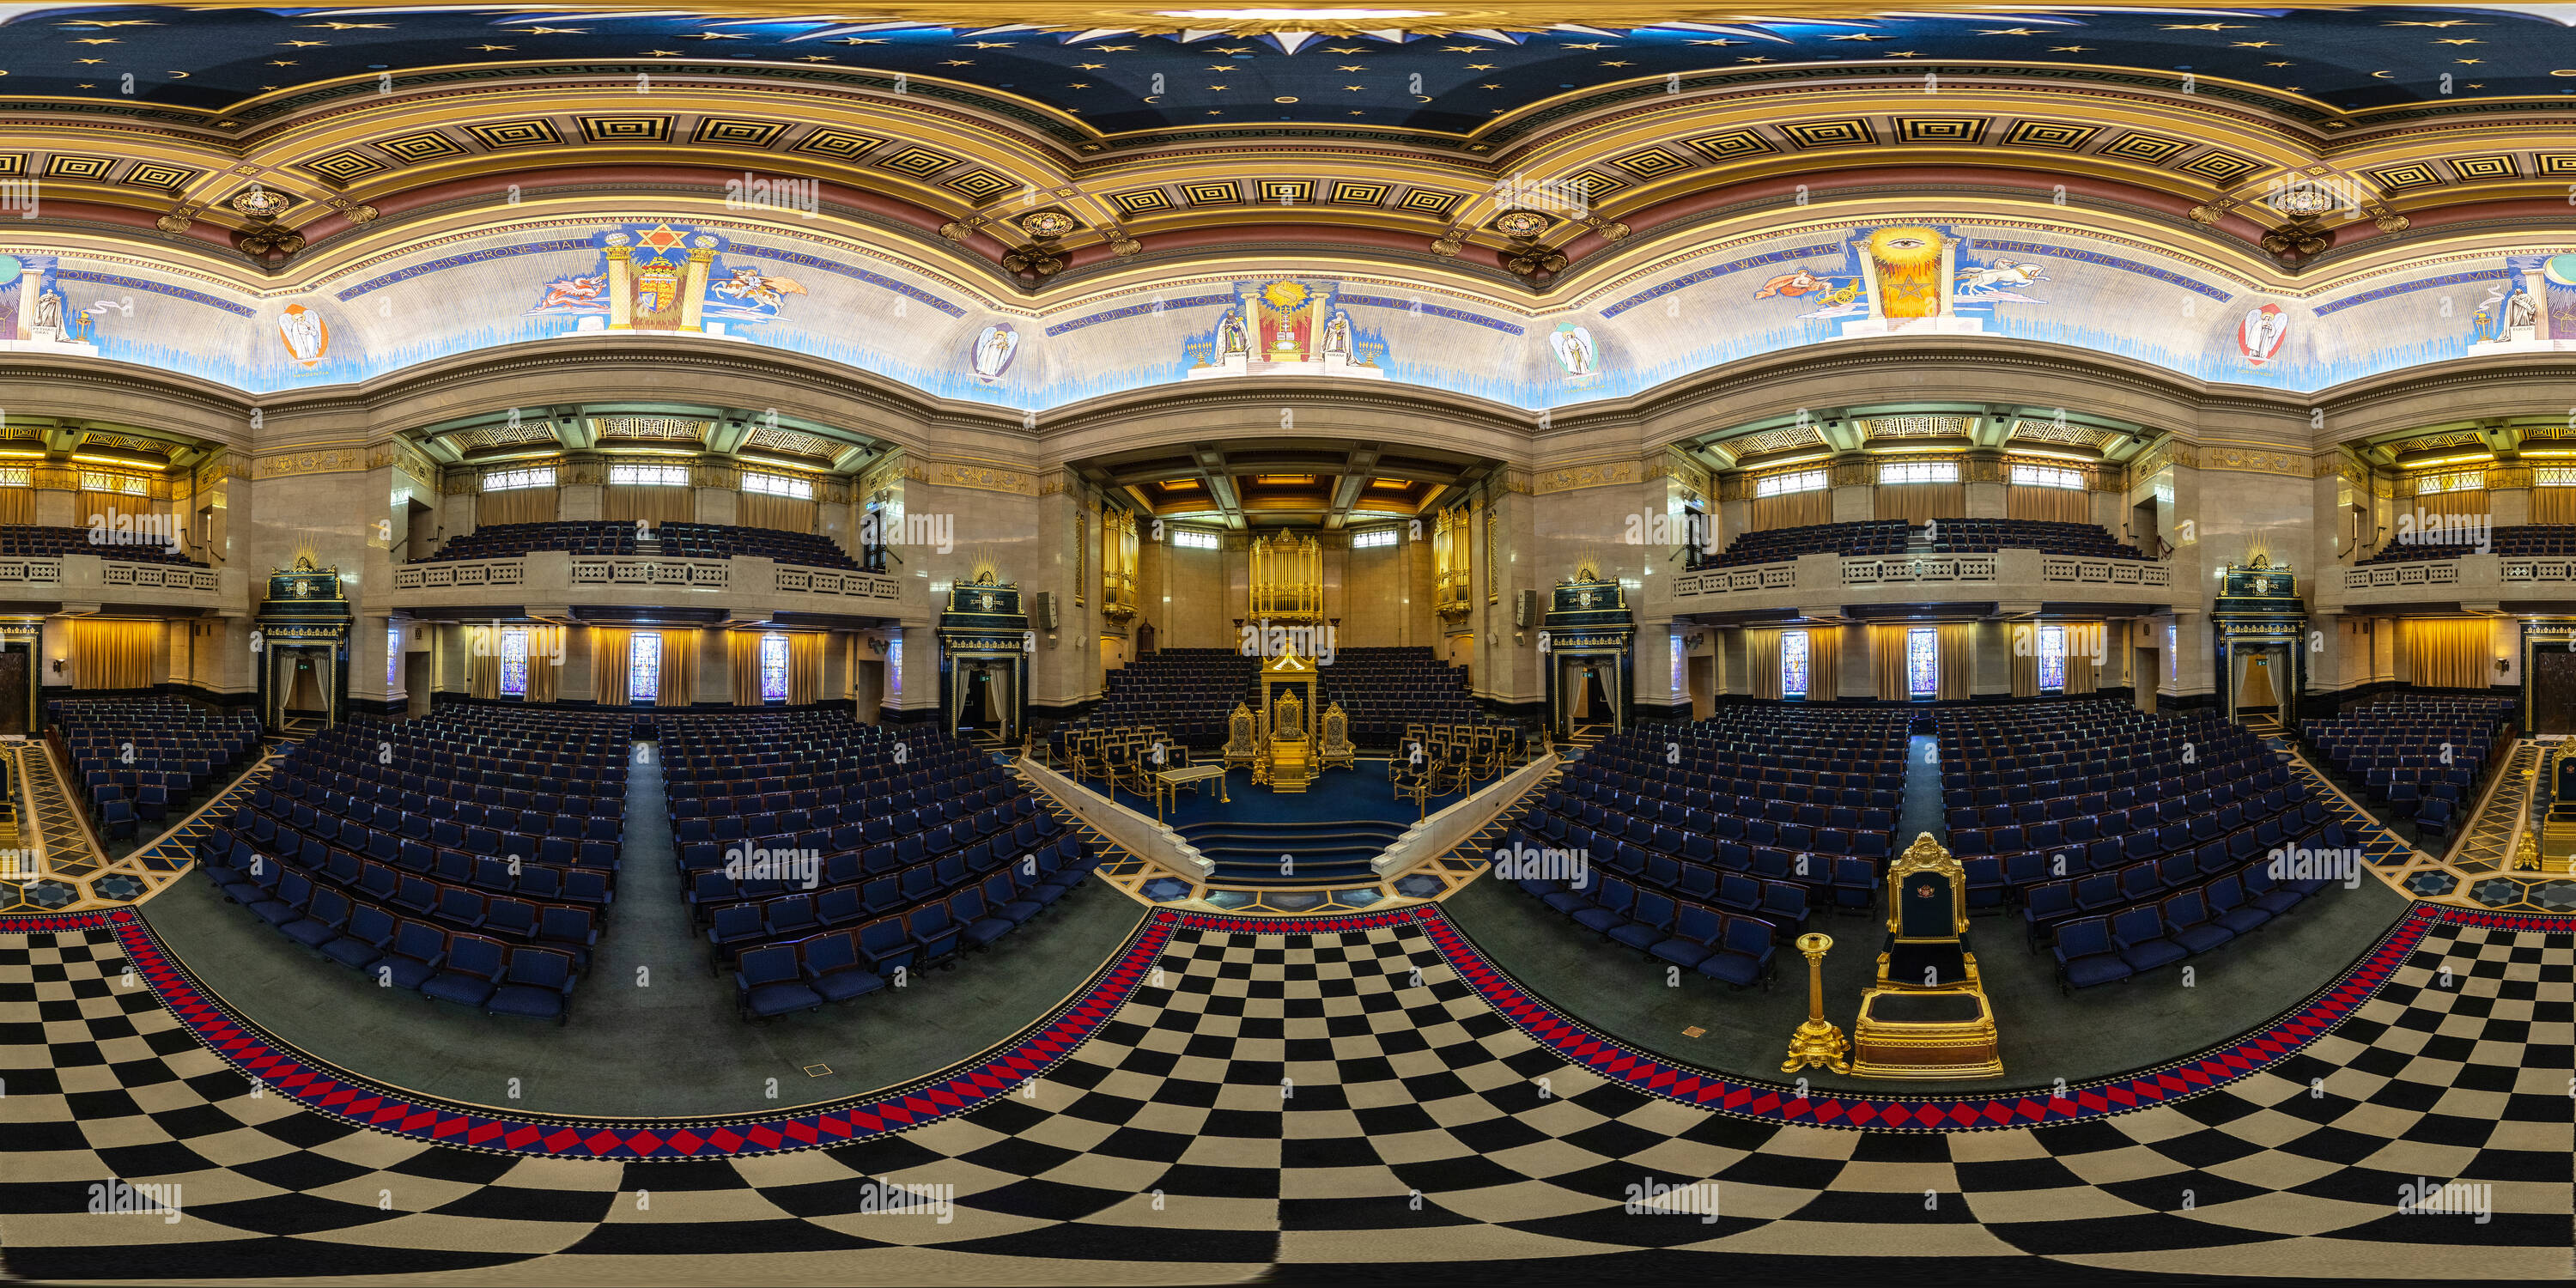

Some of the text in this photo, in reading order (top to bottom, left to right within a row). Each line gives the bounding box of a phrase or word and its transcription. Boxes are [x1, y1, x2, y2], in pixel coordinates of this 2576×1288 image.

[399, 264, 431, 279] AND
[434, 258, 459, 269] HIS
[464, 245, 532, 262] THRONE
[538, 240, 593, 252] SHALL
[728, 243, 966, 317] BE ESTABLISHED FOR EVERMORE
[1601, 292, 1650, 317] THRONE
[1723, 264, 1731, 272] I
[1733, 255, 1776, 269] WILL
[1781, 250, 1803, 260] BE
[1811, 244, 1840, 256] HIS
[1973, 240, 2231, 301] FATHER AND HE SHALL BE MY SON
[56, 270, 255, 317] HOUSE AND IN MY KINGDOM
[2320, 300, 2353, 313] WILL
[2354, 286, 2404, 302] SETTLE
[2408, 278, 2439, 289] HIM
[2444, 275, 2461, 284] IN
[2467, 270, 2509, 281] MINE
[1048, 326, 1062, 337] HE
[1064, 317, 1098, 331] SHALL
[1099, 308, 1133, 322] BUILD
[1162, 301, 1182, 310] AN
[1185, 294, 1236, 306] HOUSE
[1337, 295, 1370, 304] AND
[1434, 307, 1497, 328] STABLISH
[1503, 324, 1524, 335] HIS
